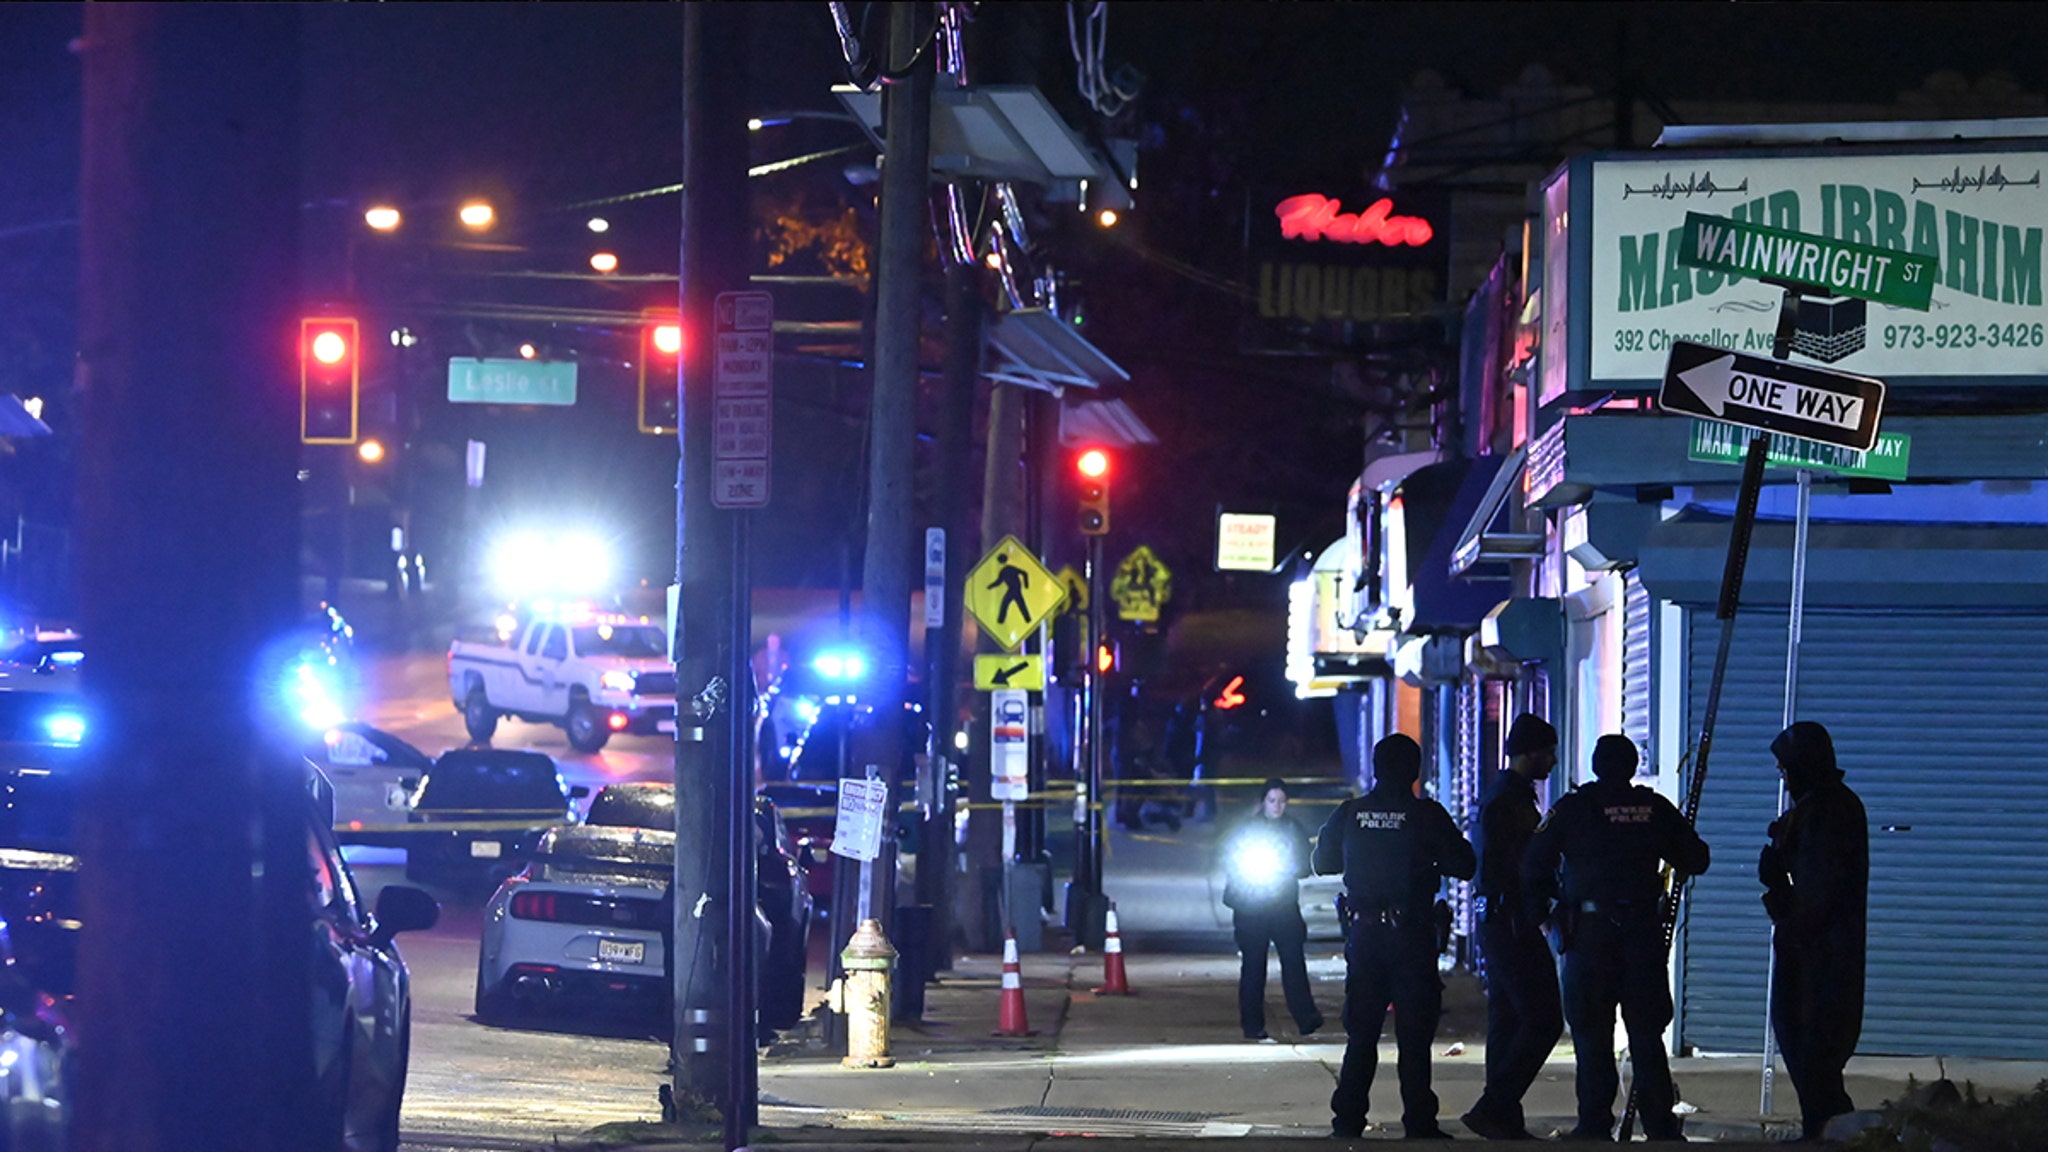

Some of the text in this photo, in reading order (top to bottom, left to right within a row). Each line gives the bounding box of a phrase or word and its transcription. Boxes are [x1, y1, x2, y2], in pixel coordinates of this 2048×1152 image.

[1618, 189, 1801, 312] MAD
[1697, 222, 1923, 294] WAINWRIGHT ST
[1614, 329, 1644, 351] 392
[1883, 322, 2044, 350] 973-923-3426
[1729, 375, 1856, 424] ONE WAY
[1695, 421, 1733, 456] IMAM
[1875, 437, 1904, 458] WAY
[1356, 811, 1407, 821] NEWARK
[1360, 820, 1401, 829] POLICE
